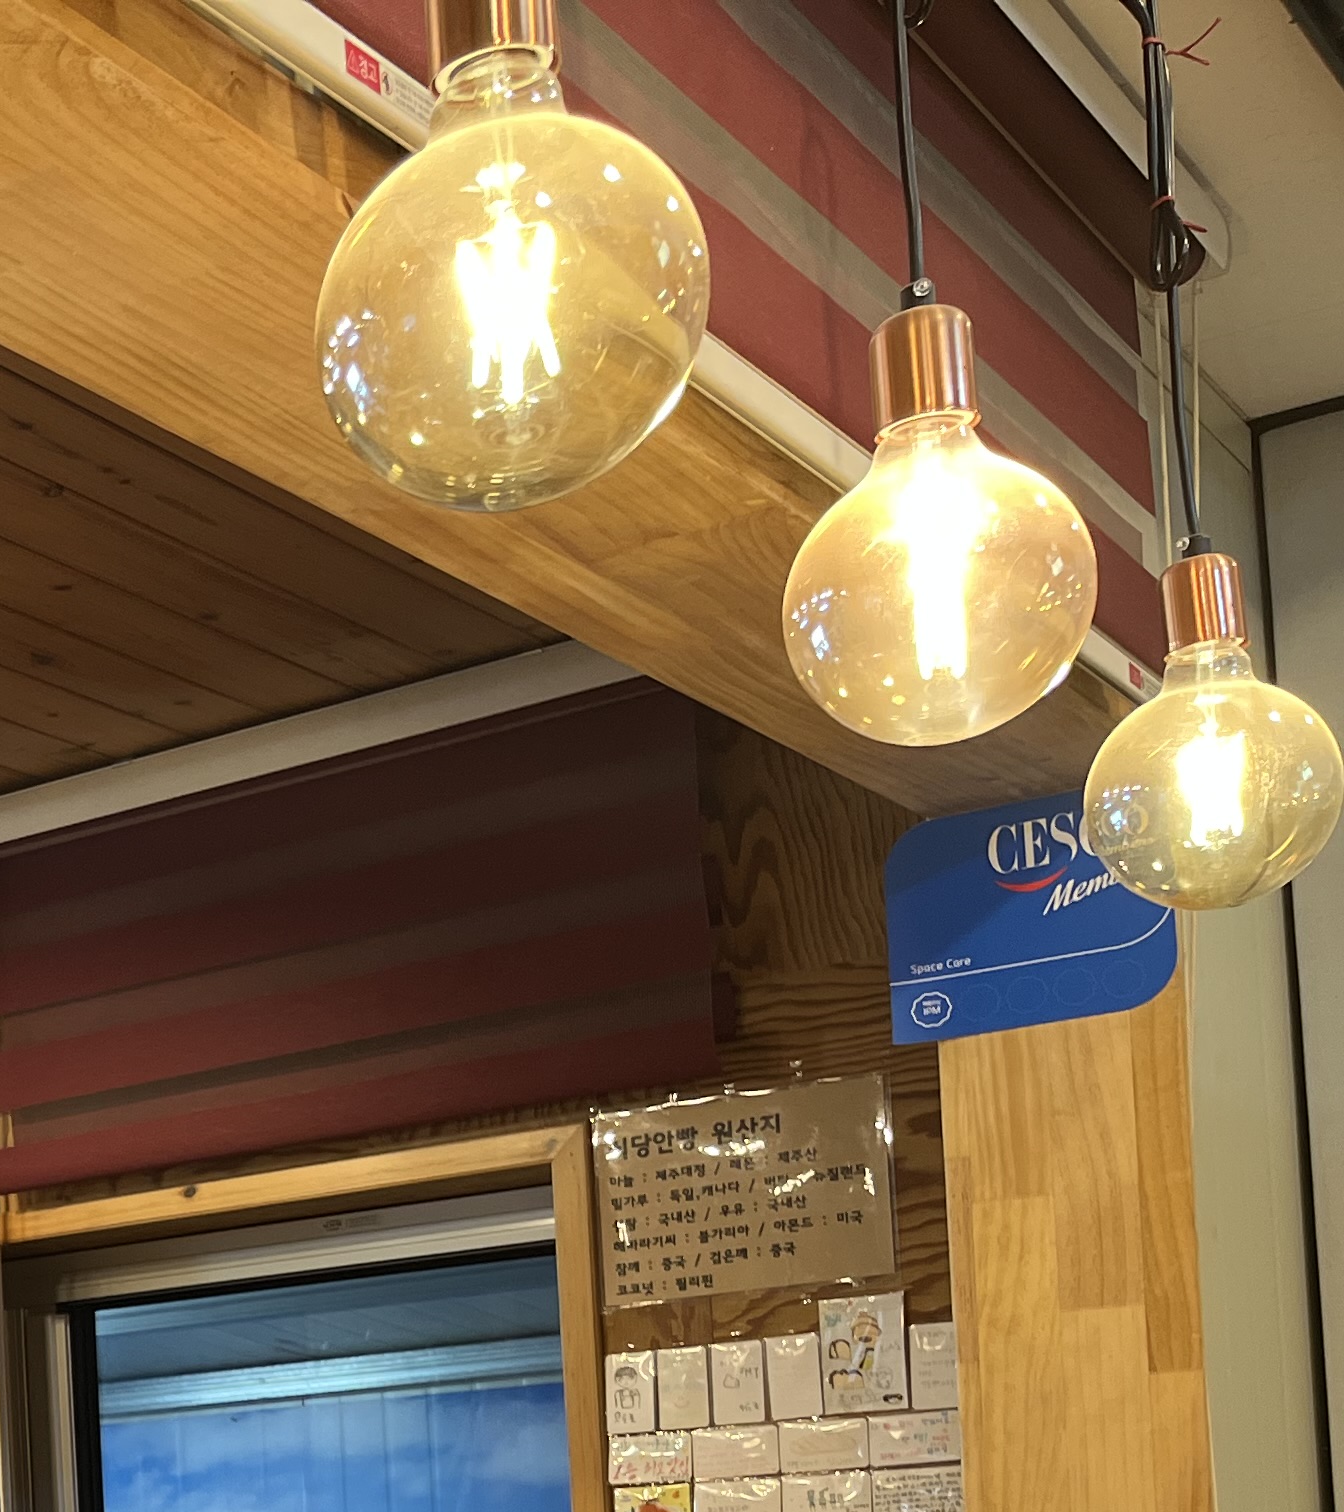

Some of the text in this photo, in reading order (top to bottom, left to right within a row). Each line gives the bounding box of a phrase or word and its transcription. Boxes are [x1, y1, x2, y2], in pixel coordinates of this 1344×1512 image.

[987, 811, 1096, 874] CES
[910, 957, 971, 975] Space Care
[712, 1113, 781, 1146] 원산지
[778, 1147, 817, 1163] 제주산
[611, 1194, 649, 1211] 밀가루
[658, 1210, 696, 1226] 국내산
[719, 1203, 746, 1217] 우유
[768, 1196, 807, 1212] 국내산
[698, 1226, 750, 1244] 불가리아
[774, 1217, 814, 1232] 아몬드
[837, 1210, 864, 1225] 미국
[661, 1255, 687, 1270] 중국
[710, 1248, 749, 1265] 검은깨
[770, 1242, 796, 1258] 중국
[616, 1273, 713, 1297] 코코넛 필리핀
